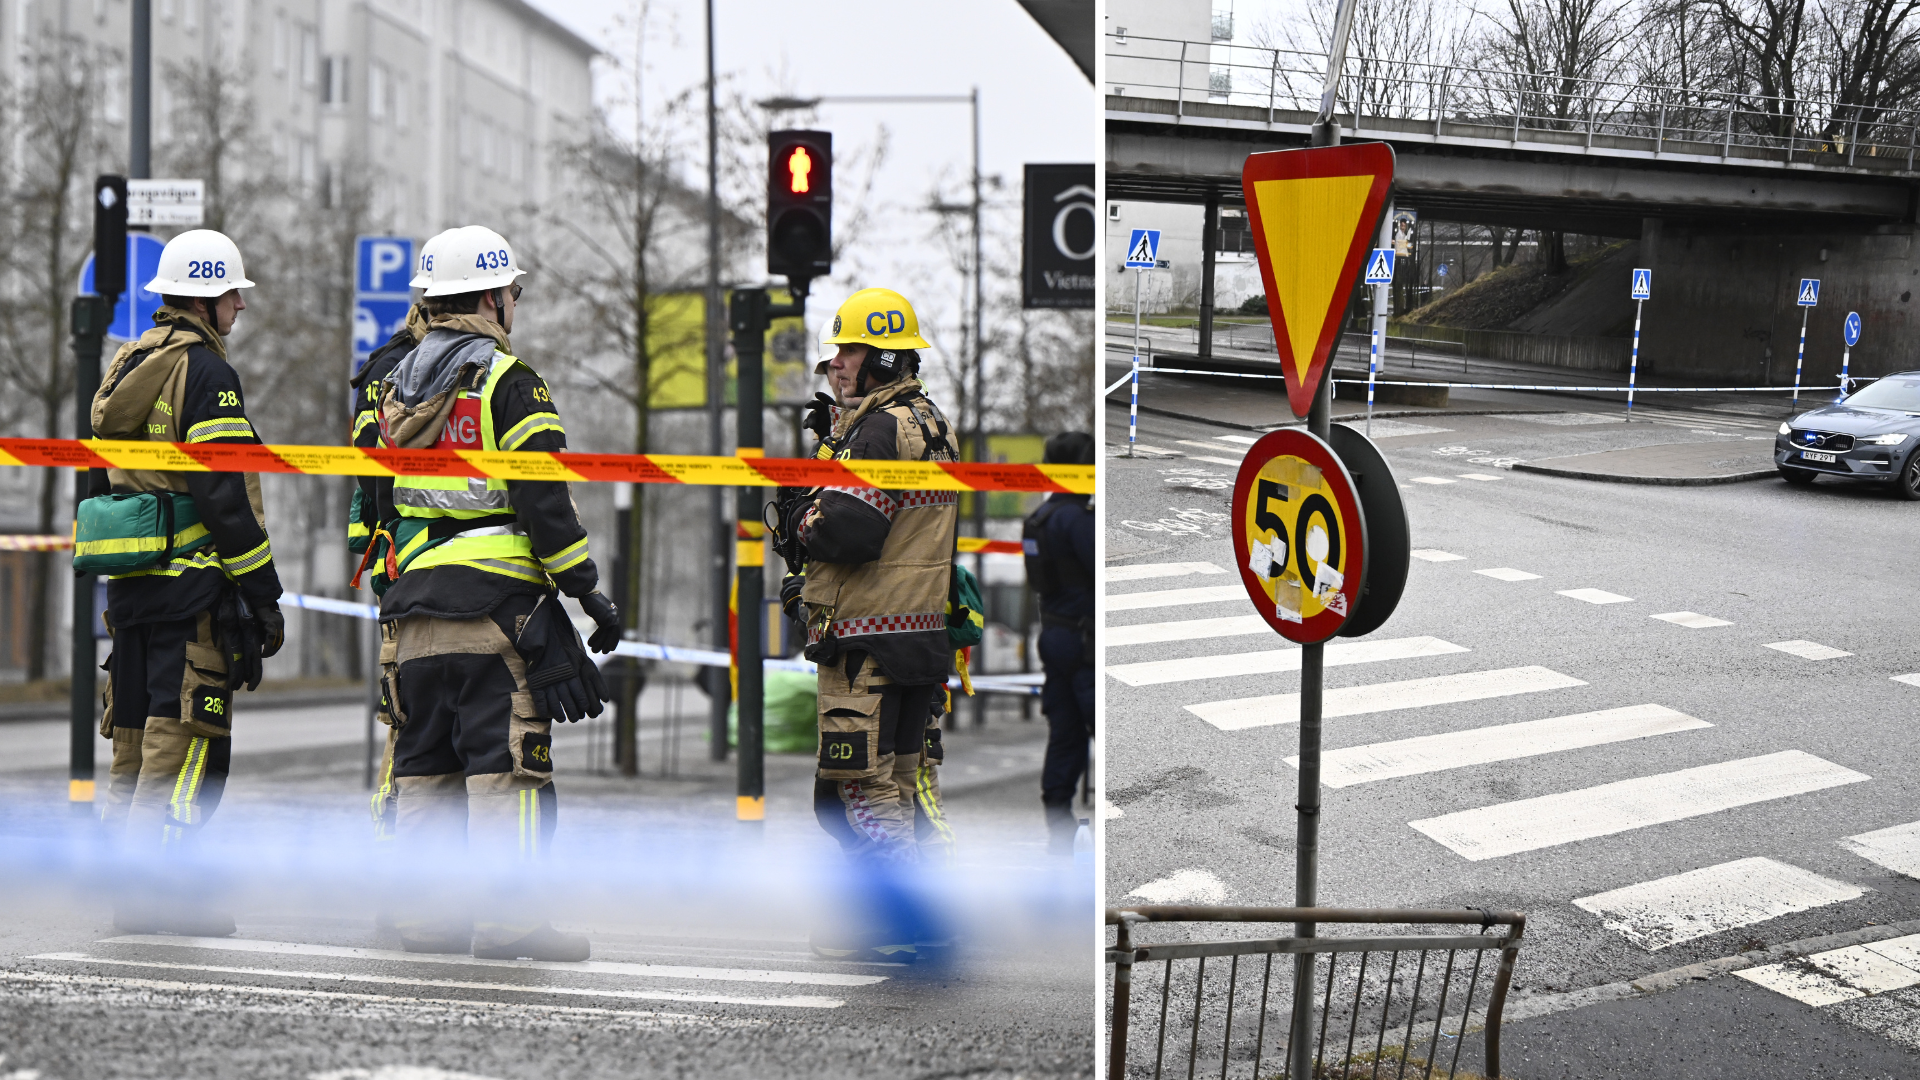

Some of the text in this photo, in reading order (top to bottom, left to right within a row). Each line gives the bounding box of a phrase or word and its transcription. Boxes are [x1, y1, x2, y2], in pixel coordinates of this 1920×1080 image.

[188, 260, 226, 279] 286
[370, 243, 404, 290] P
[476, 249, 509, 271] 439
[866, 310, 905, 336] CD
[218, 390, 241, 408] 28
[1255, 478, 1340, 593] 50
[532, 745, 550, 762] 43
[829, 742, 853, 760] CD
